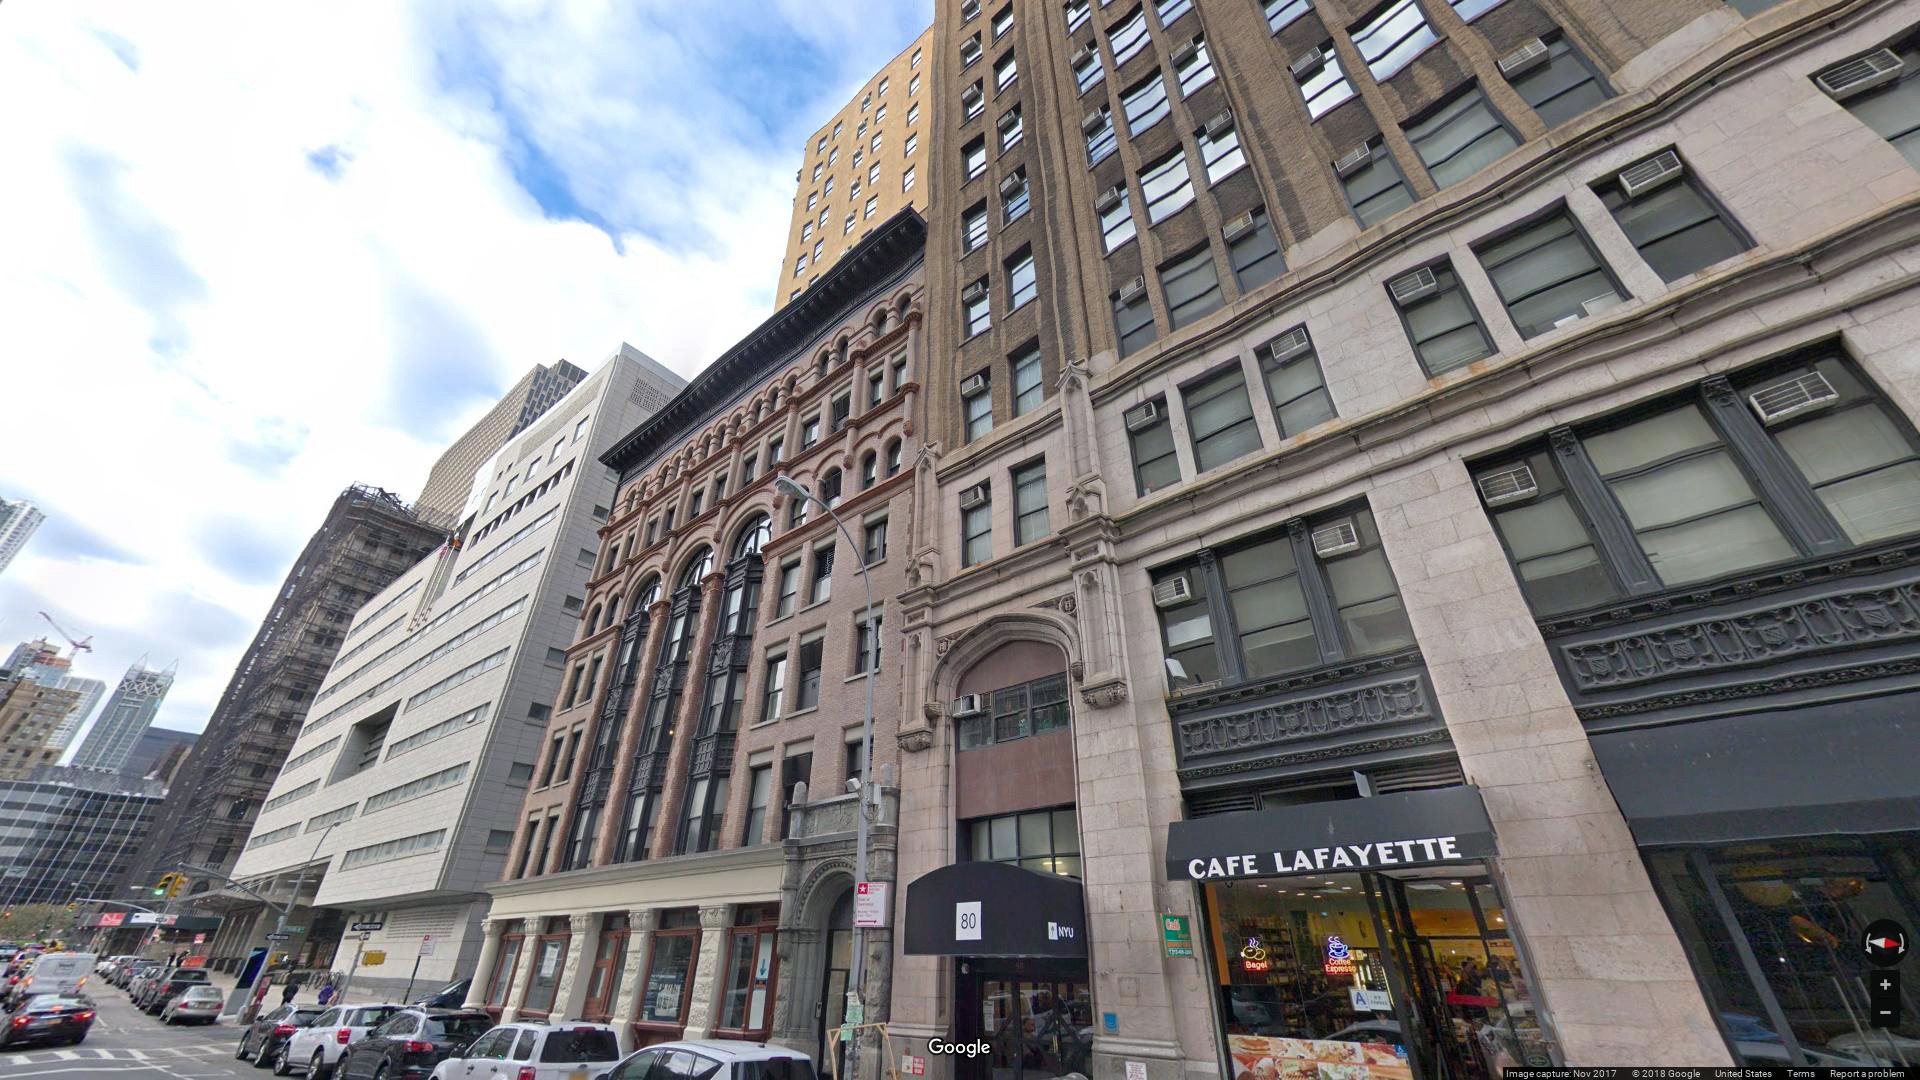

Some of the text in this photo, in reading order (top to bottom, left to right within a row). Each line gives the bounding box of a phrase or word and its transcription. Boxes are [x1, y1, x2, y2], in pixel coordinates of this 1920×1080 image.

[1188, 836, 1462, 880] CAFE LAFAYETTE
[961, 913, 976, 929] 80
[1058, 926, 1074, 938] NYU
[1245, 960, 1268, 971] Bagel
[1328, 959, 1351, 967] Coffee
[1355, 992, 1367, 1005] A
